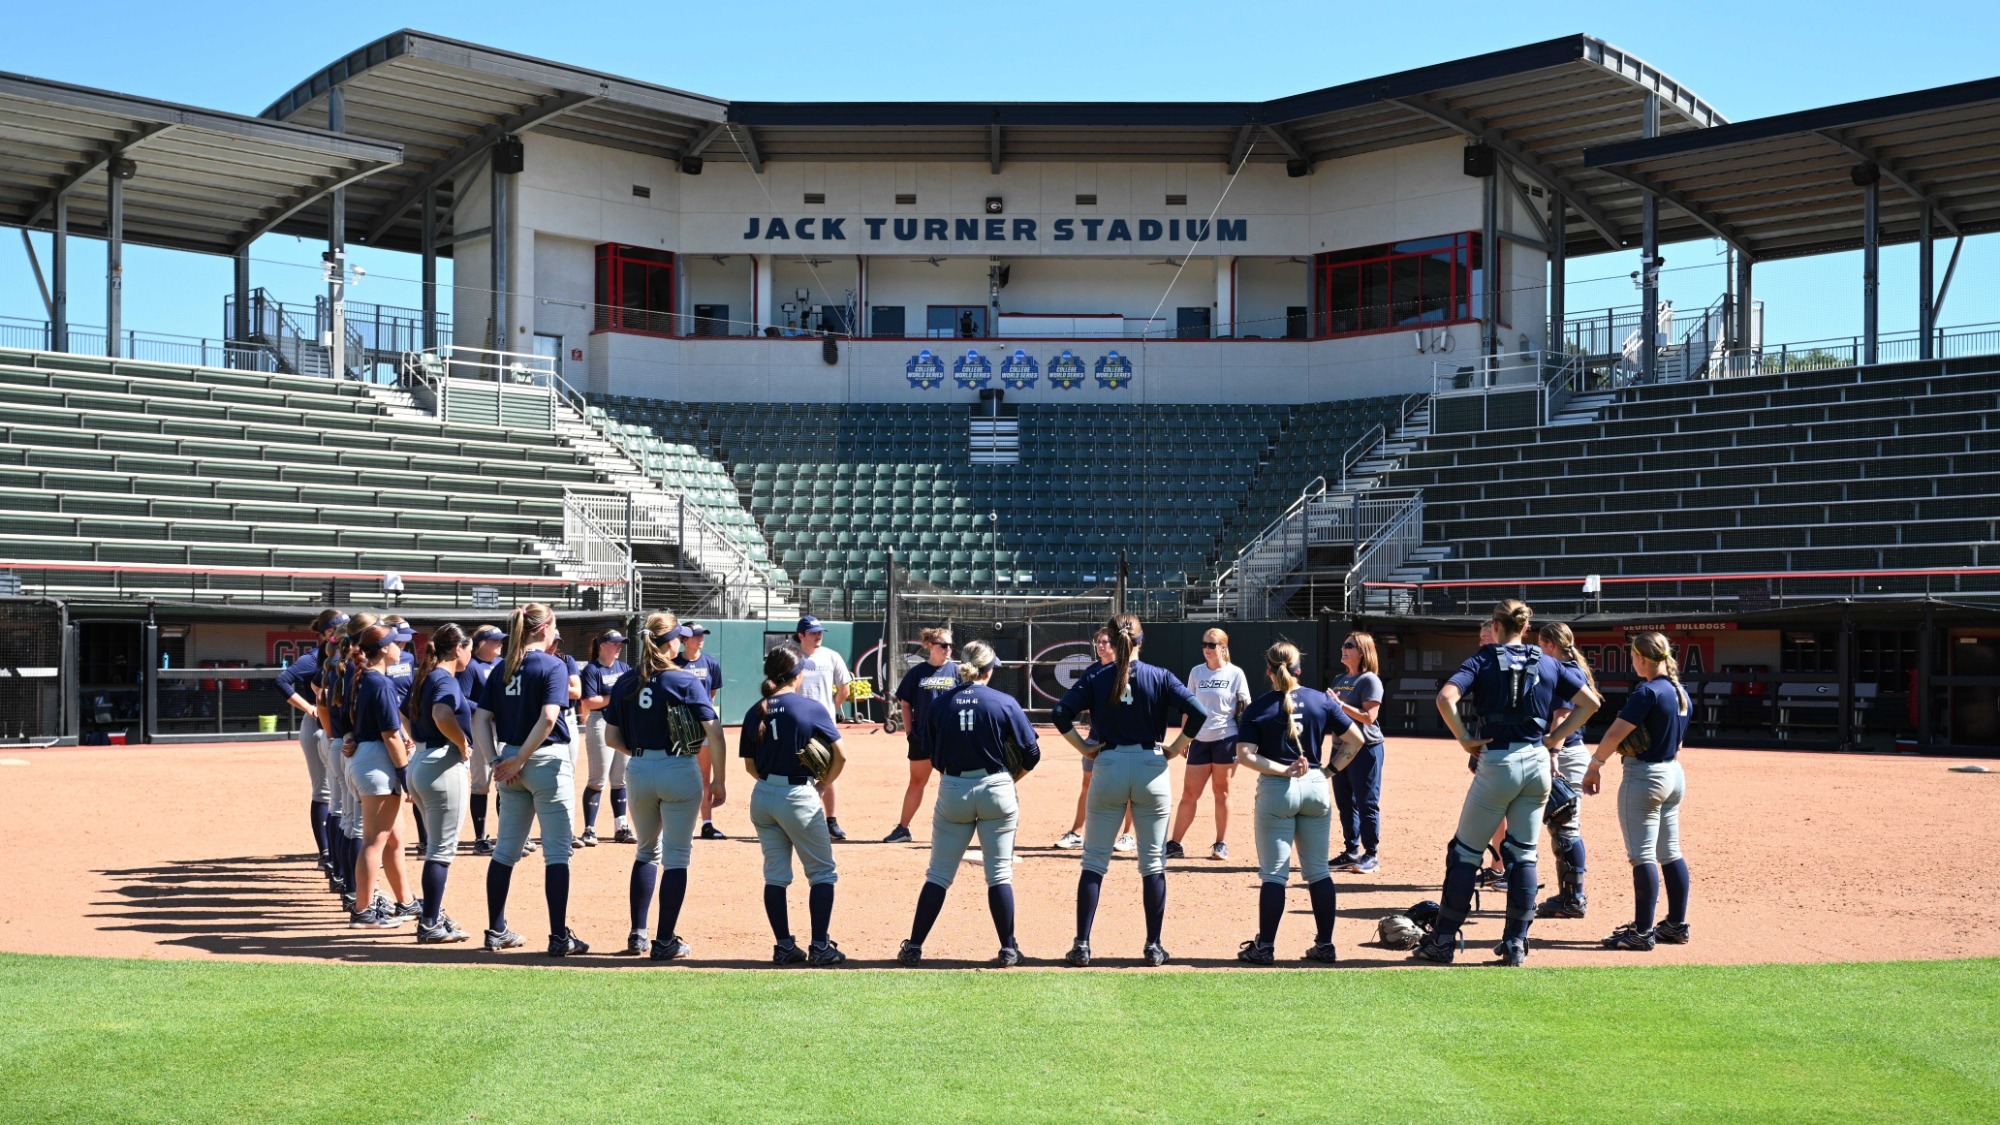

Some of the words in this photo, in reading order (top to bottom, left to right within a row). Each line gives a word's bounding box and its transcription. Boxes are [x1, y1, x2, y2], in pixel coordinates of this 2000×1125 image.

[743, 217, 847, 240] JACK
[864, 218, 1037, 241] TURNER
[1053, 219, 1247, 242] STADIUM
[505, 675, 522, 696] 21
[918, 676, 955, 687] UNCG
[1199, 679, 1230, 689] UNCG
[638, 687, 653, 709] 6
[1120, 683, 1134, 705] 4
[770, 718, 779, 741] 1
[958, 708, 974, 732] 11
